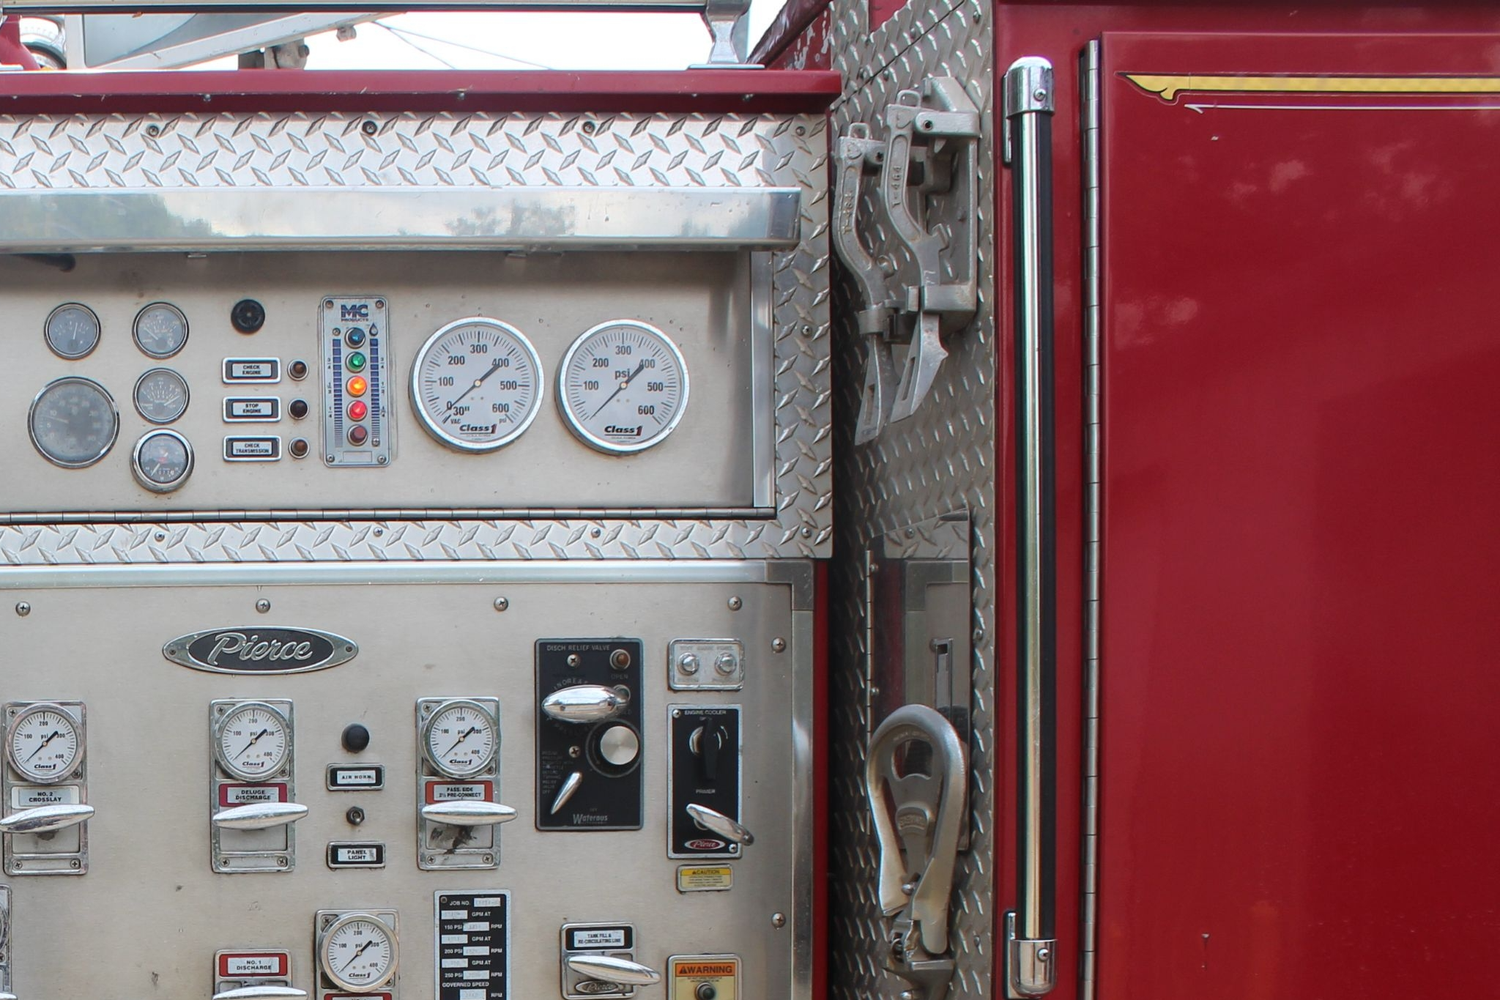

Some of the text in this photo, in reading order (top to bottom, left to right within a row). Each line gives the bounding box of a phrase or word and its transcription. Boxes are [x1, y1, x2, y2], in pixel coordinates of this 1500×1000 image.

[340, 304, 369, 318] MC
[469, 343, 488, 354] 300
[615, 345, 632, 356] 300
[447, 355, 466, 366] 200
[491, 358, 510, 368] 400
[592, 358, 609, 368] 200
[639, 358, 656, 369] 400
[614, 368, 631, 380] psi
[438, 376, 455, 387] 100
[500, 380, 518, 391] 500
[583, 380, 599, 391] 100
[647, 381, 664, 392] 500
[446, 400, 453, 411] 0
[492, 403, 510, 413] 600
[637, 404, 655, 415] 600
[207, 632, 313, 666] Pierce
[572, 813, 608, 824] Waterous
[687, 966, 732, 974] WARNING
